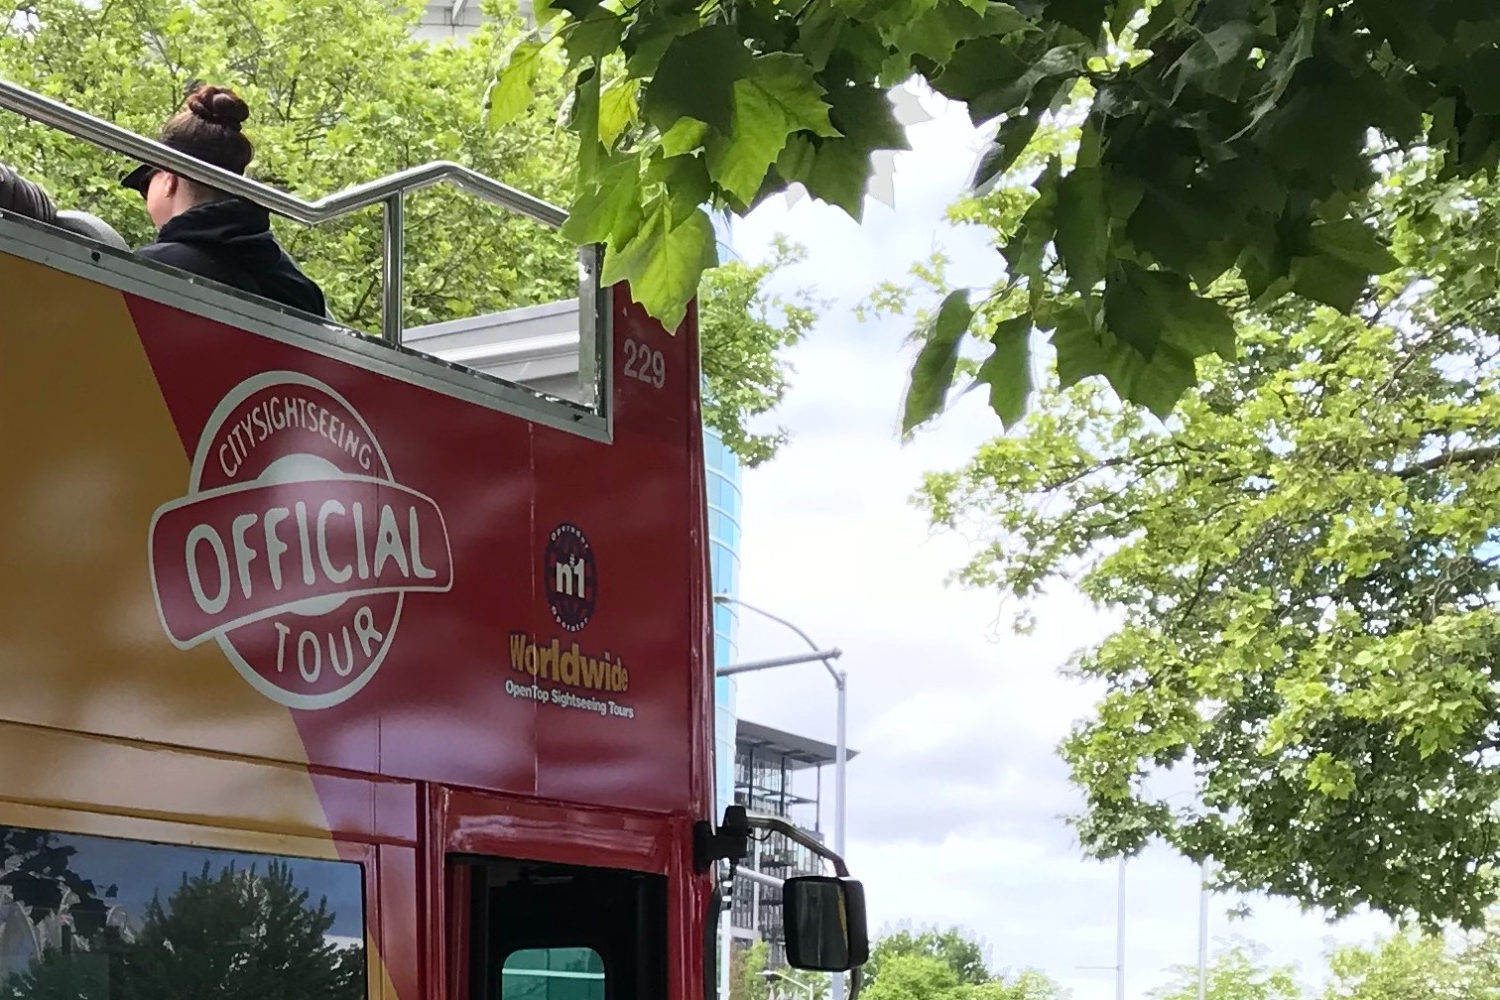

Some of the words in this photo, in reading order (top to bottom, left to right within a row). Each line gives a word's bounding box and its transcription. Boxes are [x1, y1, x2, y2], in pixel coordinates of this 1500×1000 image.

[623, 338, 666, 389] 229
[218, 396, 372, 478] CITYSIGHTSEEING
[185, 500, 437, 614] OFFICIAL
[274, 606, 383, 683] TOUR
[509, 633, 629, 692] Worldwide
[505, 679, 549, 703] OpenTop
[551, 688, 607, 716] Sightseeing
[608, 700, 635, 719] Tours
